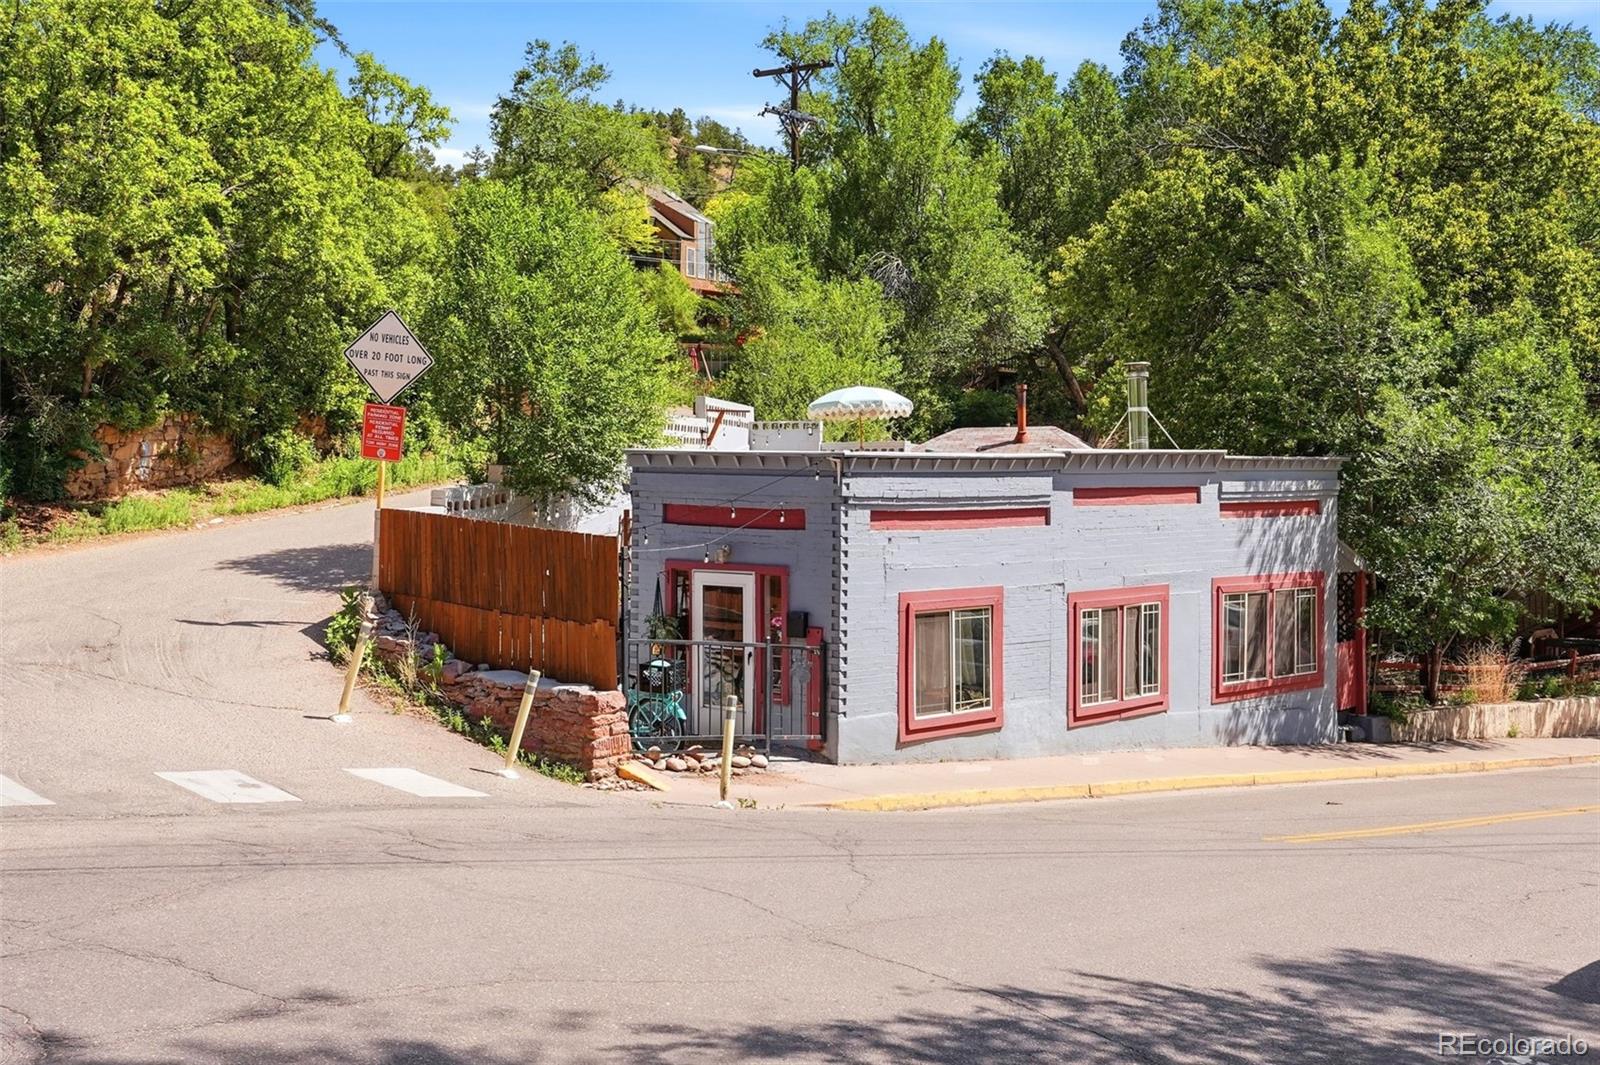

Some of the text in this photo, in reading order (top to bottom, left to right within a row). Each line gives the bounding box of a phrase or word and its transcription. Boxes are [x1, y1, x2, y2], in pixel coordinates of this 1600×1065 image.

[369, 332, 410, 346] NO VEHICLES
[349, 349, 428, 366] OVER 20 FOOT LONG
[363, 368, 411, 380] PAST THIS SIGN
